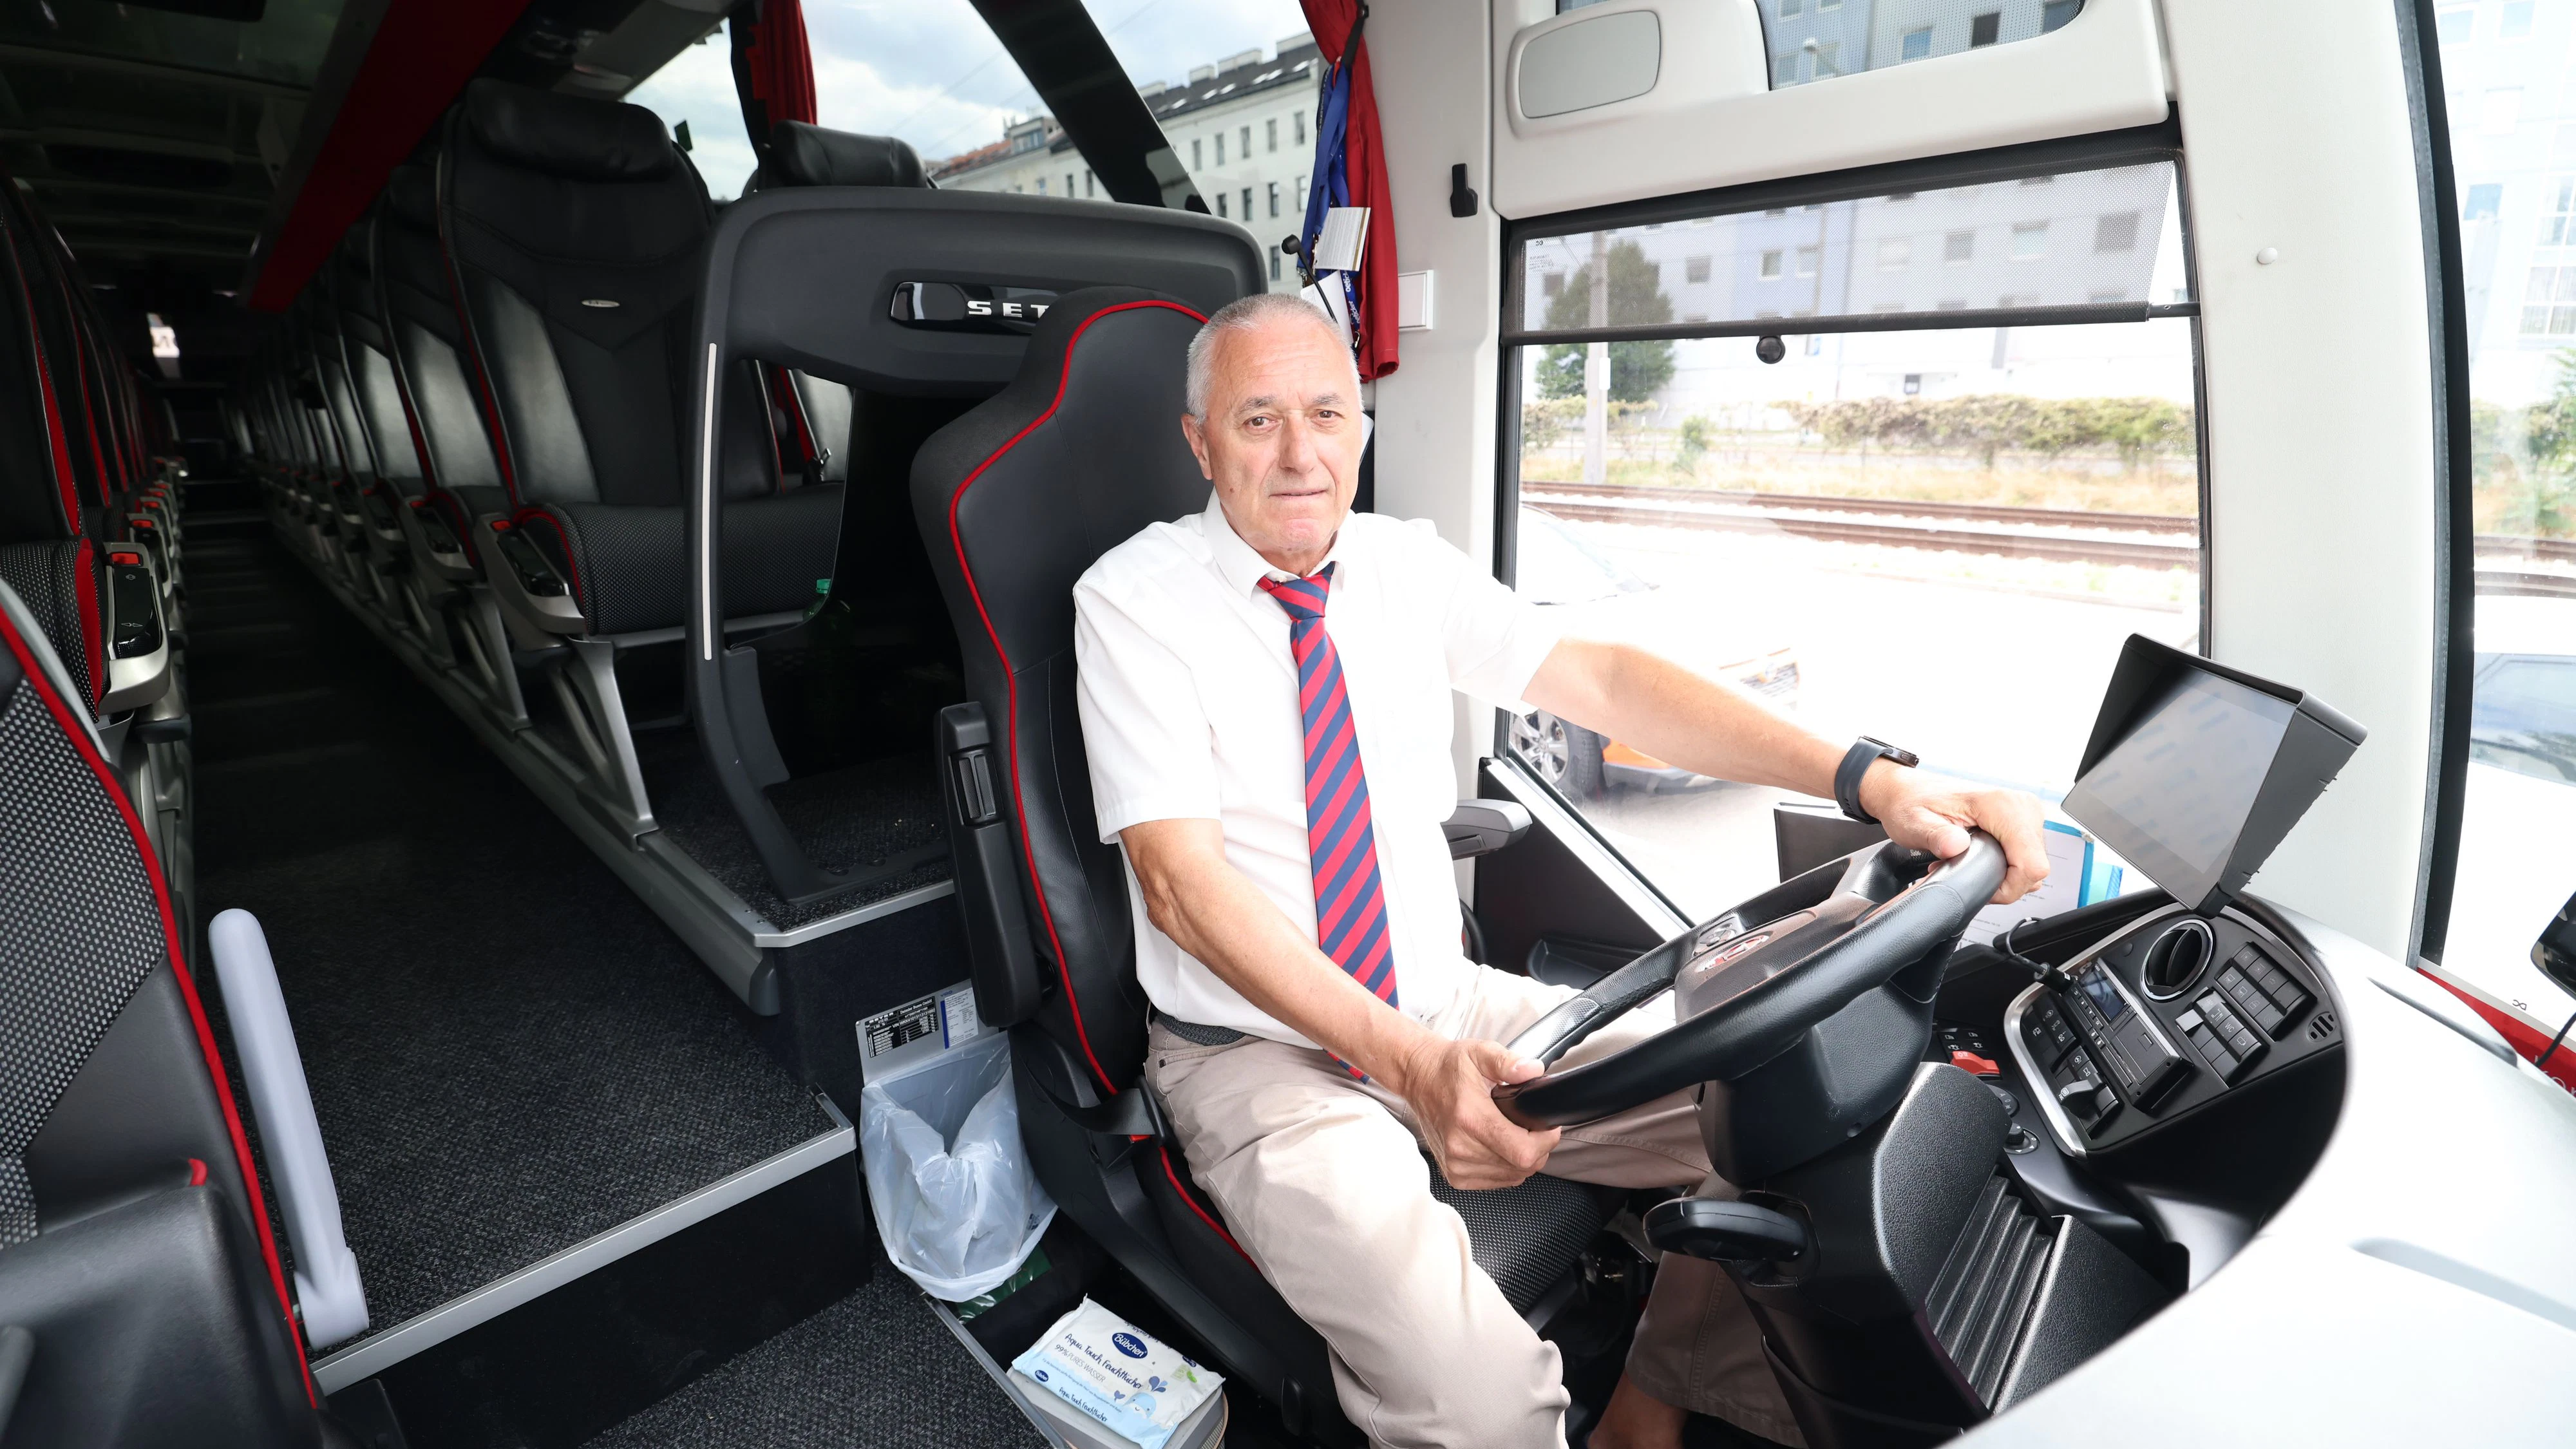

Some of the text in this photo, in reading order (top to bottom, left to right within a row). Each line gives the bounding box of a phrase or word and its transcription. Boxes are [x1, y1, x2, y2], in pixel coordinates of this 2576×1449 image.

[1343, 270, 1351, 292] oetick
[968, 300, 1050, 318] SET
[2224, 1022, 2235, 1032] WC
[1113, 1333, 1145, 1358] Bübchen
[1055, 1344, 1106, 1383] 99% PURES WASSER
[1065, 1333, 1142, 1390] Aqua Touch Feuchttücher
[1059, 1387, 1070, 1400] Aqua
[1070, 1392, 1082, 1407] Touch
